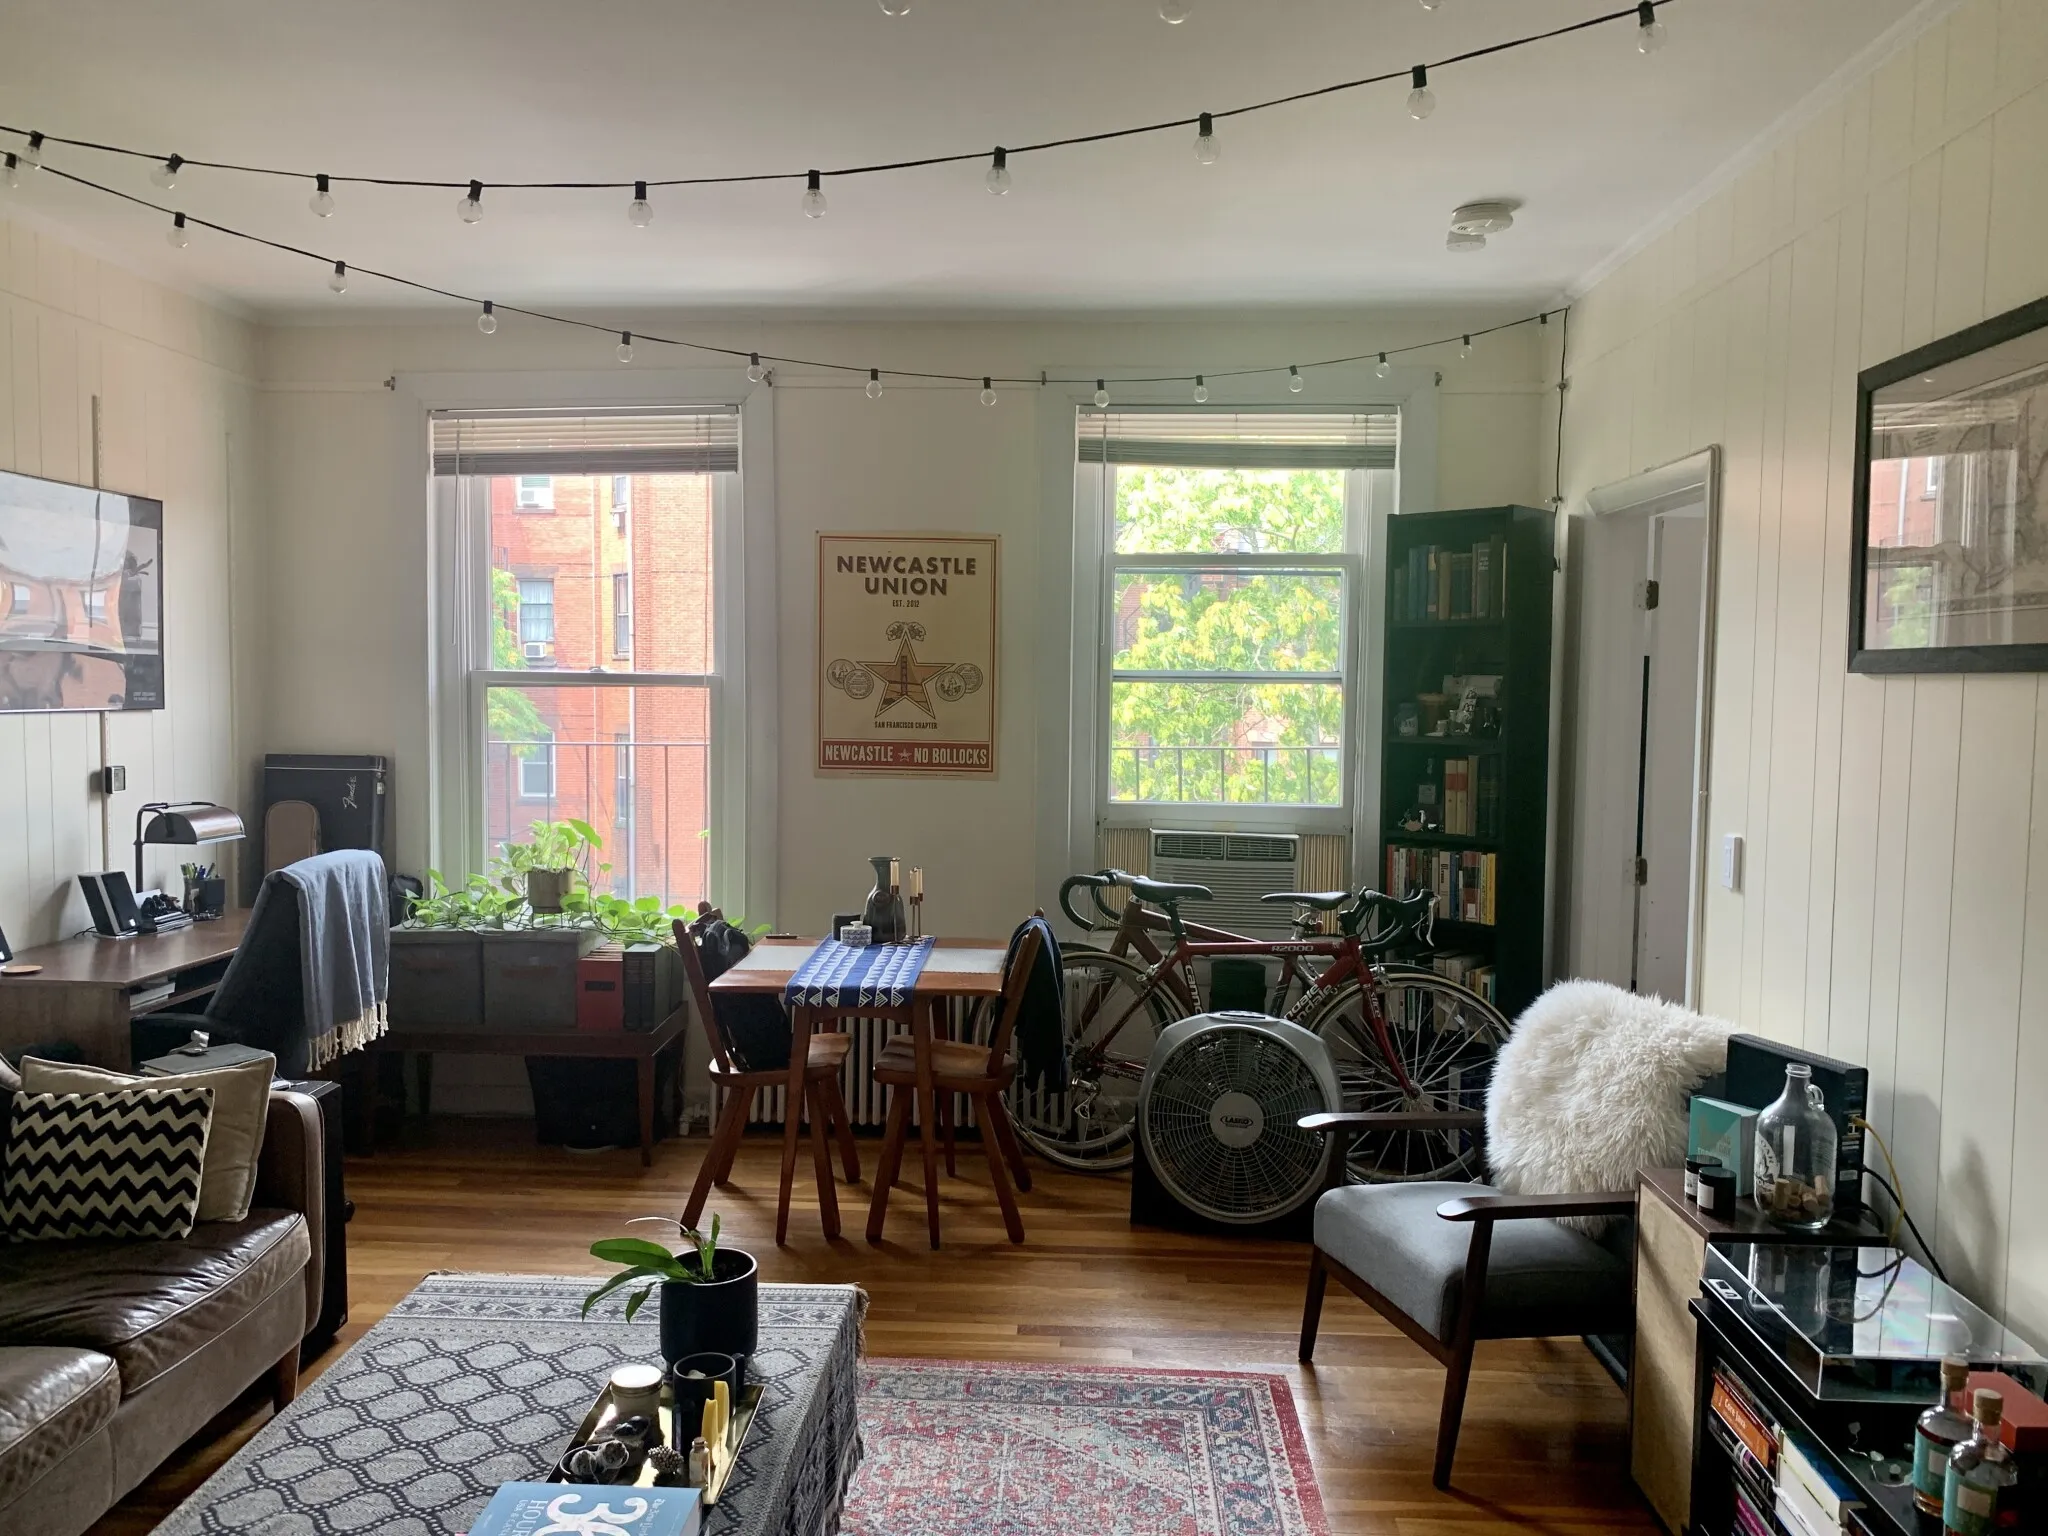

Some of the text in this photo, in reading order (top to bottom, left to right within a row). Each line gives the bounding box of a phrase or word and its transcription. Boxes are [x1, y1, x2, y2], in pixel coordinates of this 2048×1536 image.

[837, 556, 976, 575] NEWCASTLE
[865, 577, 947, 596] UNION
[892, 599, 905, 608] EST.
[874, 721, 885, 729] SAN
[915, 722, 938, 730] CHAPTER
[825, 744, 987, 765] NEWCASTLE NO BOLLOCKS
[1185, 964, 1203, 1014] canno
[1284, 984, 1320, 1019] ndale
[1103, 1066, 1143, 1081] cannond
[511, 1499, 549, 1536] HOUR
